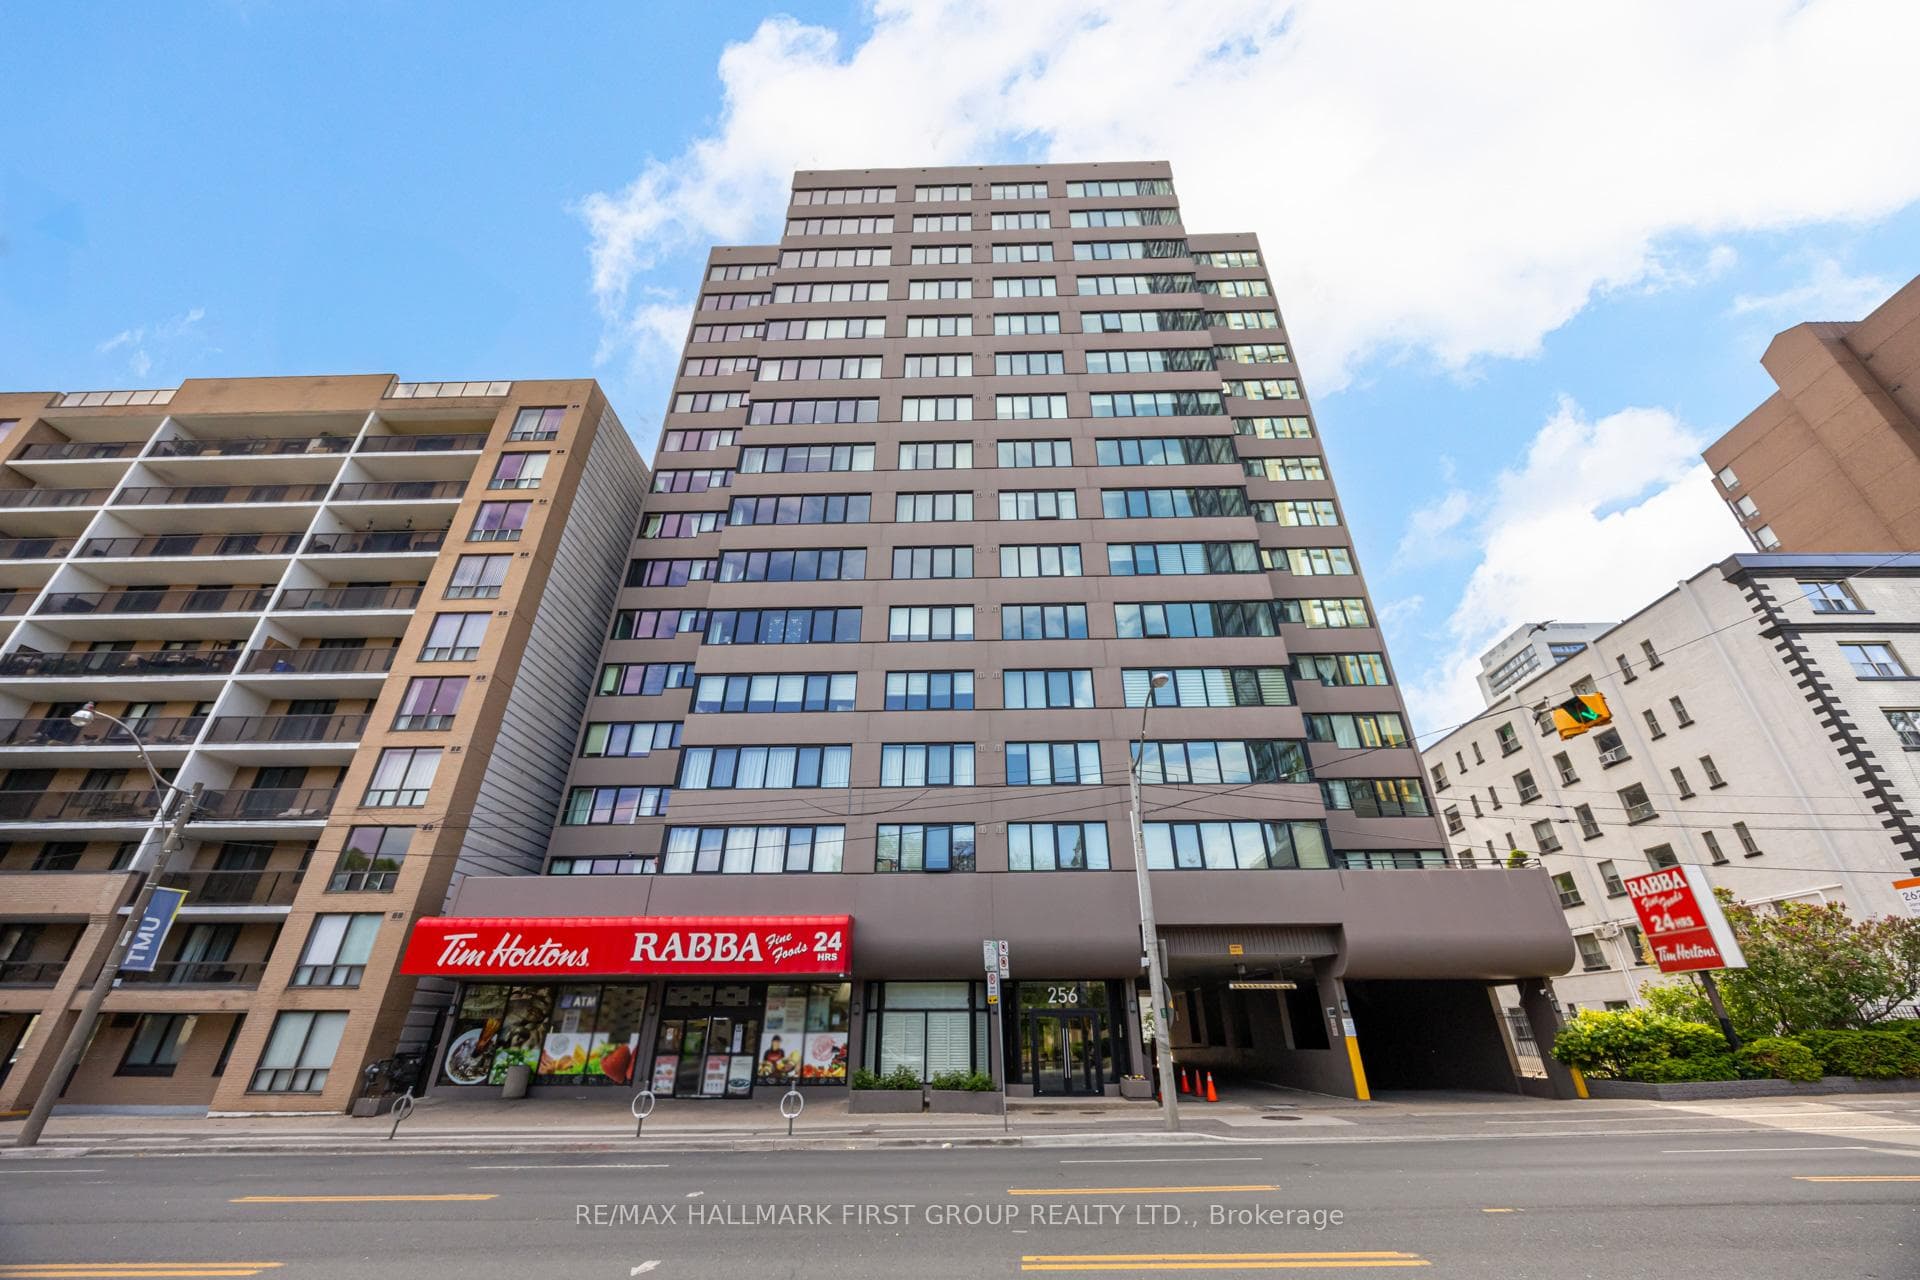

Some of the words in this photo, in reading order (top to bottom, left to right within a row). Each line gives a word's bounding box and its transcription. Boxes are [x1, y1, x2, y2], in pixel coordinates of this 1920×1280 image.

[1626, 870, 1688, 899] RABBA
[1650, 913, 1676, 932] 24
[124, 917, 161, 965] TMU
[437, 933, 486, 967] Tim
[487, 932, 589, 967] Hortons
[630, 932, 764, 962] RABBA
[765, 932, 793, 950] Fine
[813, 931, 843, 952] 24
[771, 941, 809, 964] Foods
[817, 952, 838, 962] HRS
[1655, 945, 1677, 963] Tim
[572, 996, 597, 1007] ATM
[1047, 986, 1078, 1004] 256
